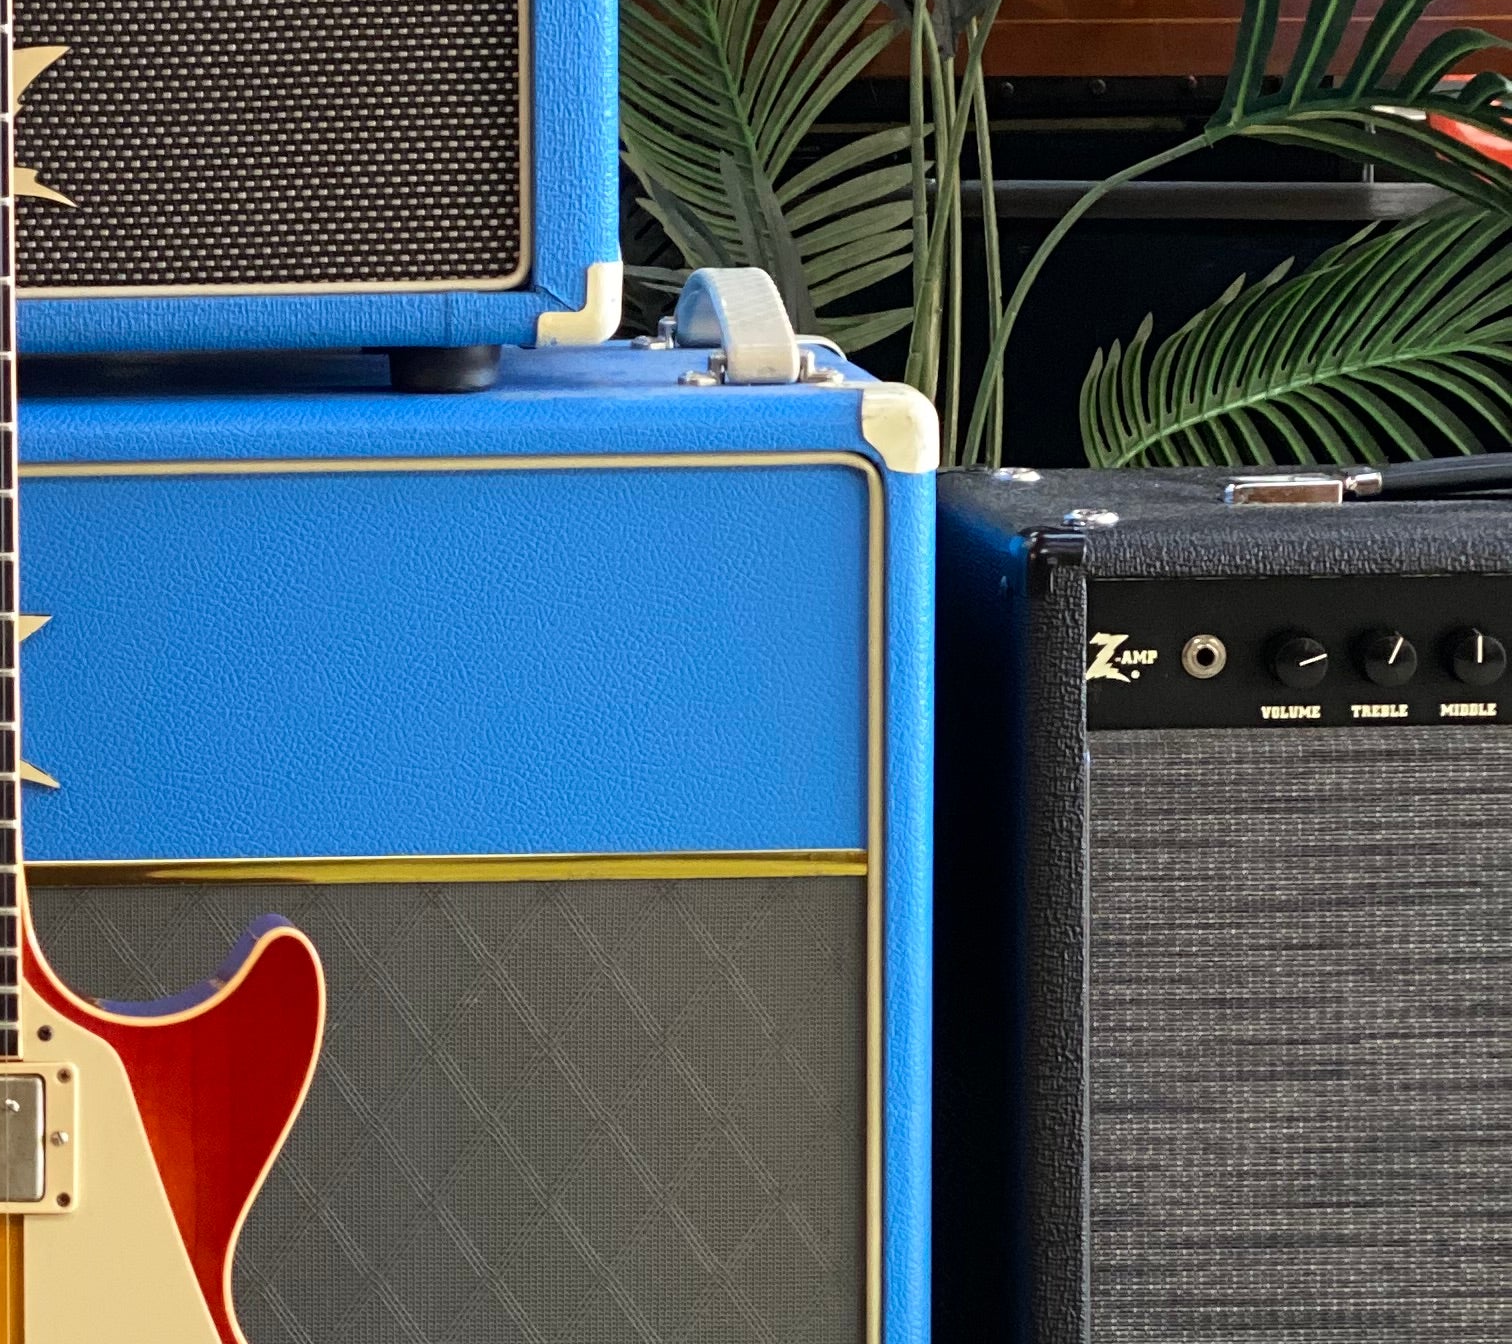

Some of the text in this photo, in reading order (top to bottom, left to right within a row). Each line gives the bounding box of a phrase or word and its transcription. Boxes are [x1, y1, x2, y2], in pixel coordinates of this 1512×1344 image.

[1260, 703, 1498, 720] VOLUME TREBLE MIDDLE
